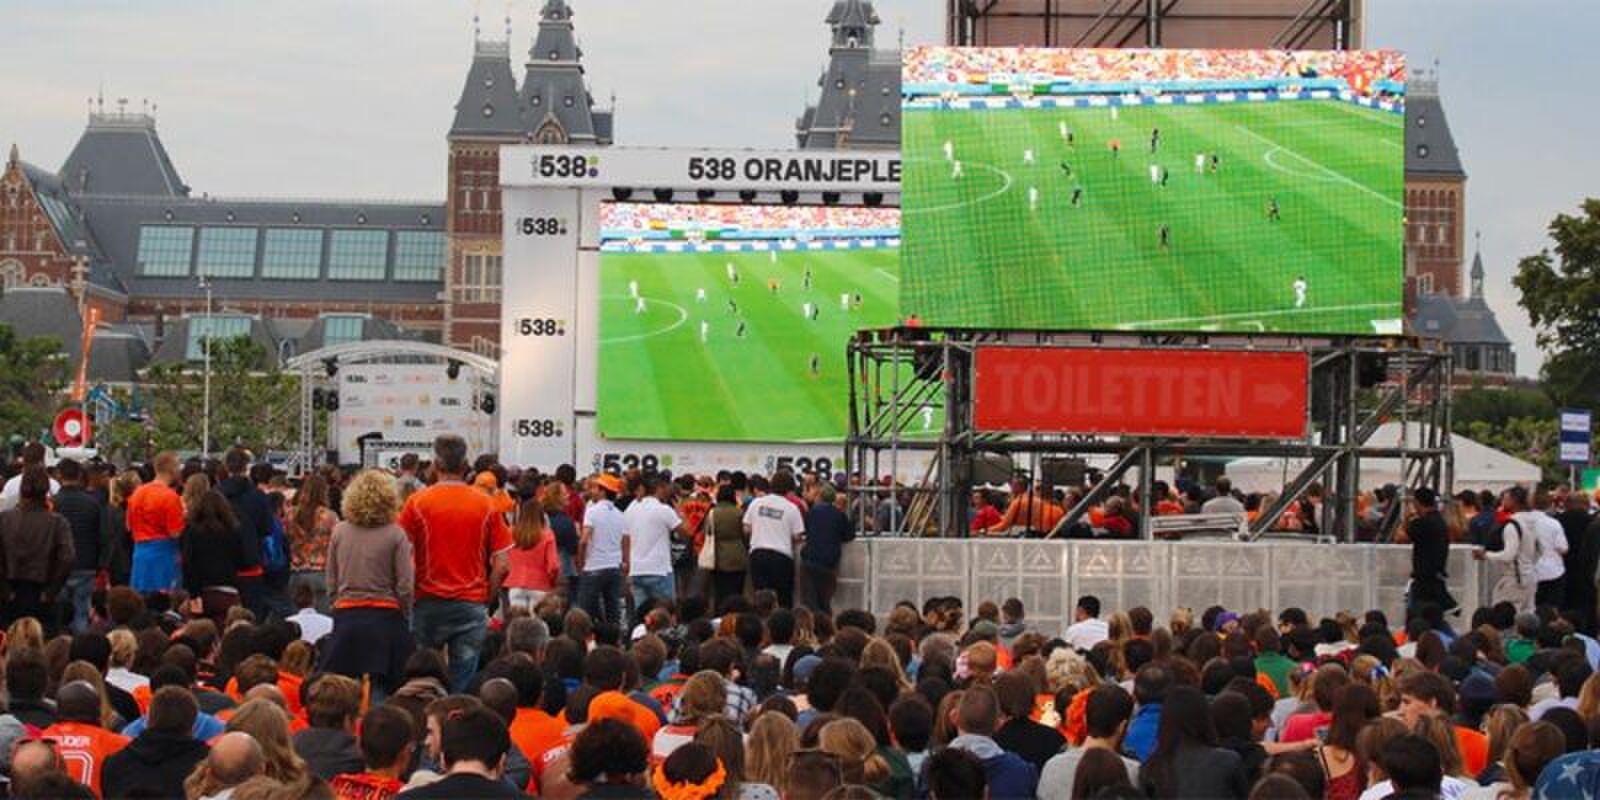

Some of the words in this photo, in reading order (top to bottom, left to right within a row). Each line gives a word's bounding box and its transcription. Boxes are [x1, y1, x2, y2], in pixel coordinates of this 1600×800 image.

[540, 155, 587, 177] 538
[688, 157, 736, 180] 538
[744, 158, 902, 182] ORANJEPLE
[522, 217, 559, 235] 538
[520, 318, 556, 336] 538
[994, 362, 1245, 418] TOILETTEN
[518, 419, 554, 437] 538
